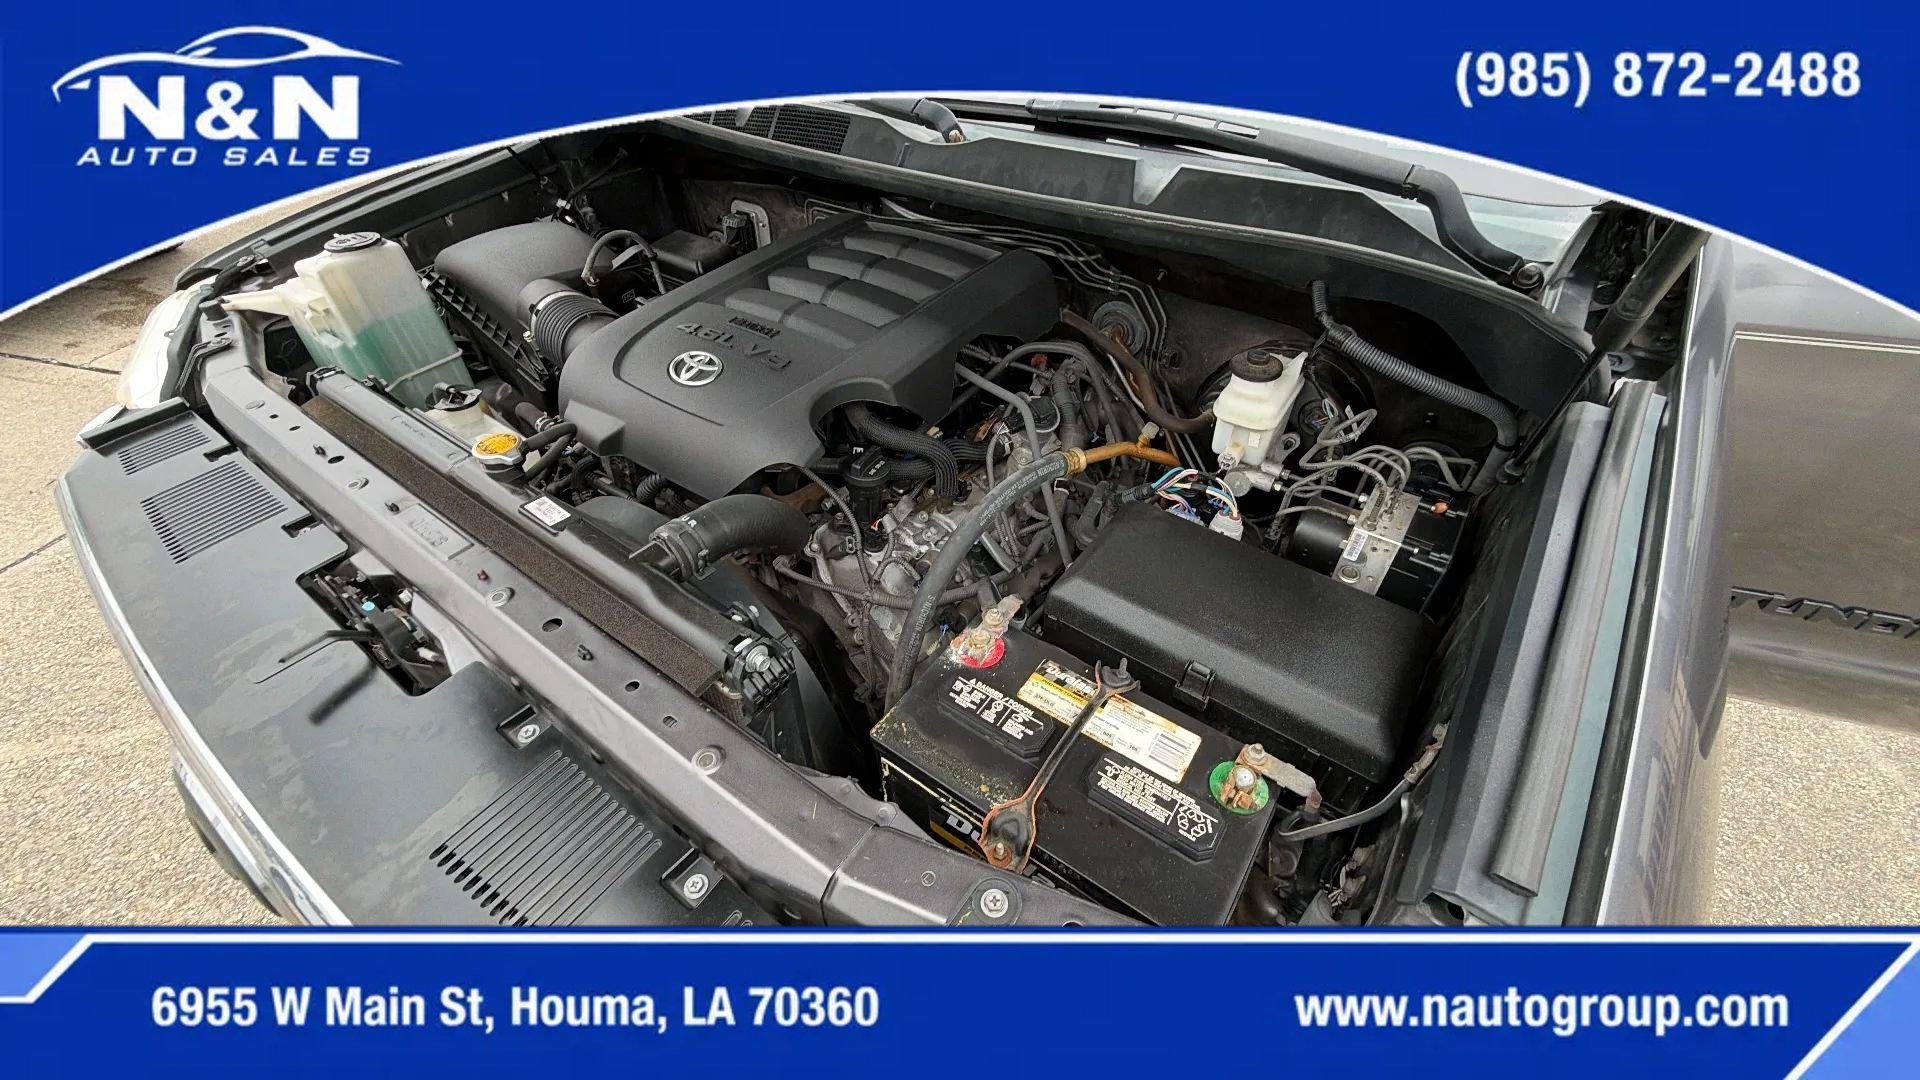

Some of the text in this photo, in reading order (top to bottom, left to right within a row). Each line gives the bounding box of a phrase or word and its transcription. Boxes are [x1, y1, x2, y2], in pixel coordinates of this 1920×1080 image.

[1731, 586, 1920, 641] TUND
[976, 681, 1004, 700] DANGER
[1007, 698, 1034, 717] POISON
